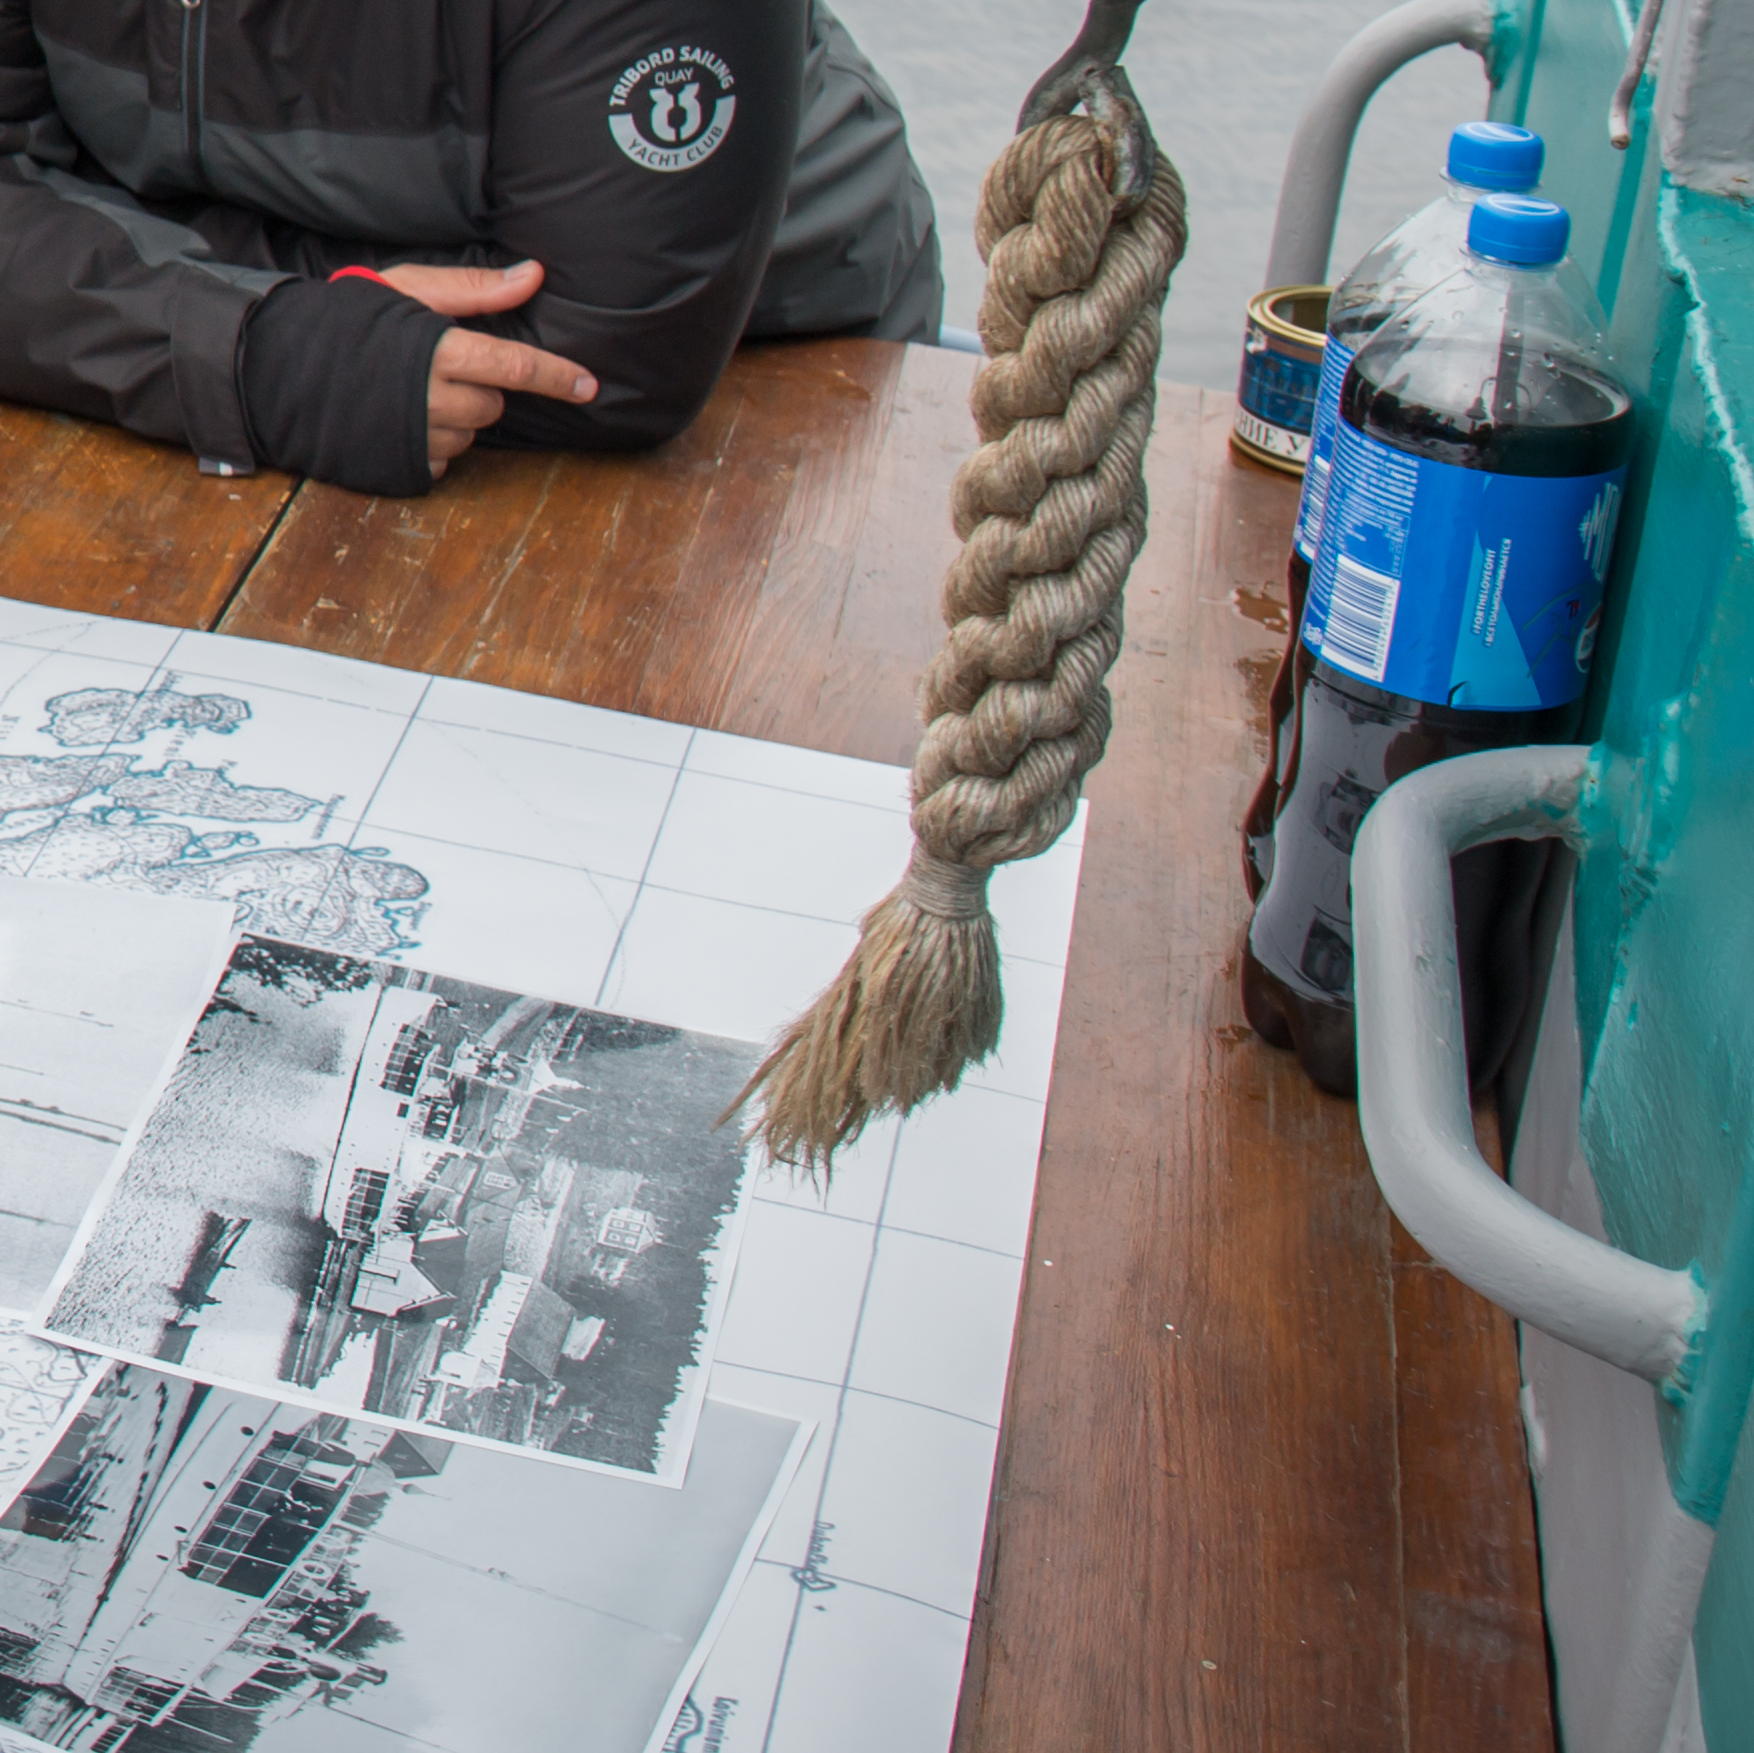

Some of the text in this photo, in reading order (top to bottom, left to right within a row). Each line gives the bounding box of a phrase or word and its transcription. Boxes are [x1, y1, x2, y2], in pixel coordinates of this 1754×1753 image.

[609, 45, 734, 107] TRIBORD SAILING
[654, 66, 694, 87] QUAY
[628, 125, 722, 167] YACHT CLUB
